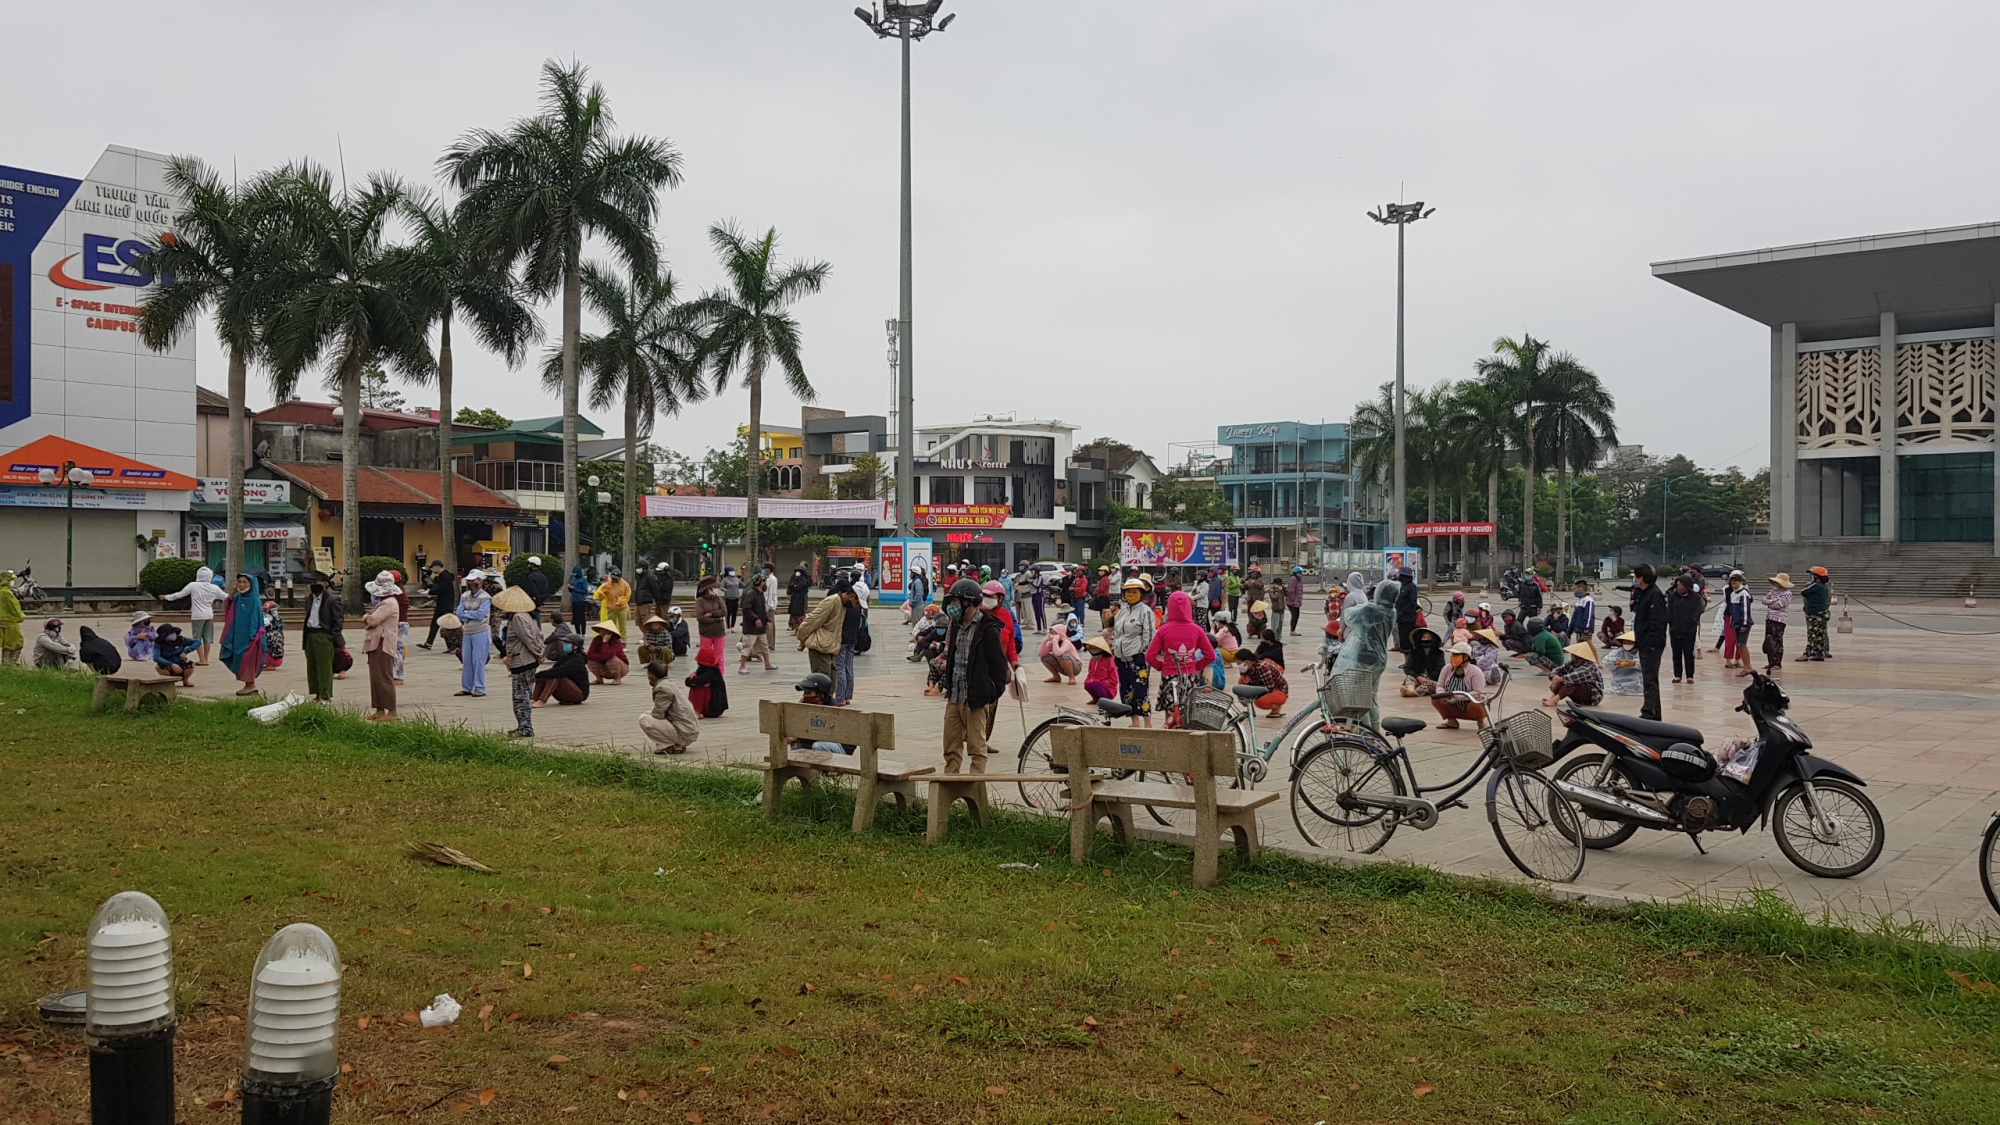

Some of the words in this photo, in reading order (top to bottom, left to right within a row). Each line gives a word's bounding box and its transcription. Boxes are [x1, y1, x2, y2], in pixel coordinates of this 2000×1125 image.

[26, 184, 60, 198] ENGLISH
[95, 185, 138, 204] TRUNG
[144, 194, 171, 210] TÂM
[74, 199, 101, 214] ANH
[136, 209, 168, 225] QUỐC
[56, 297, 63, 307] E
[70, 299, 102, 312] SPACE
[86, 316, 137, 332] CAMPUS
[260, 530, 289, 538] LONG
[811, 719, 826, 728] BIDV
[1120, 744, 1141, 755] BIDV
